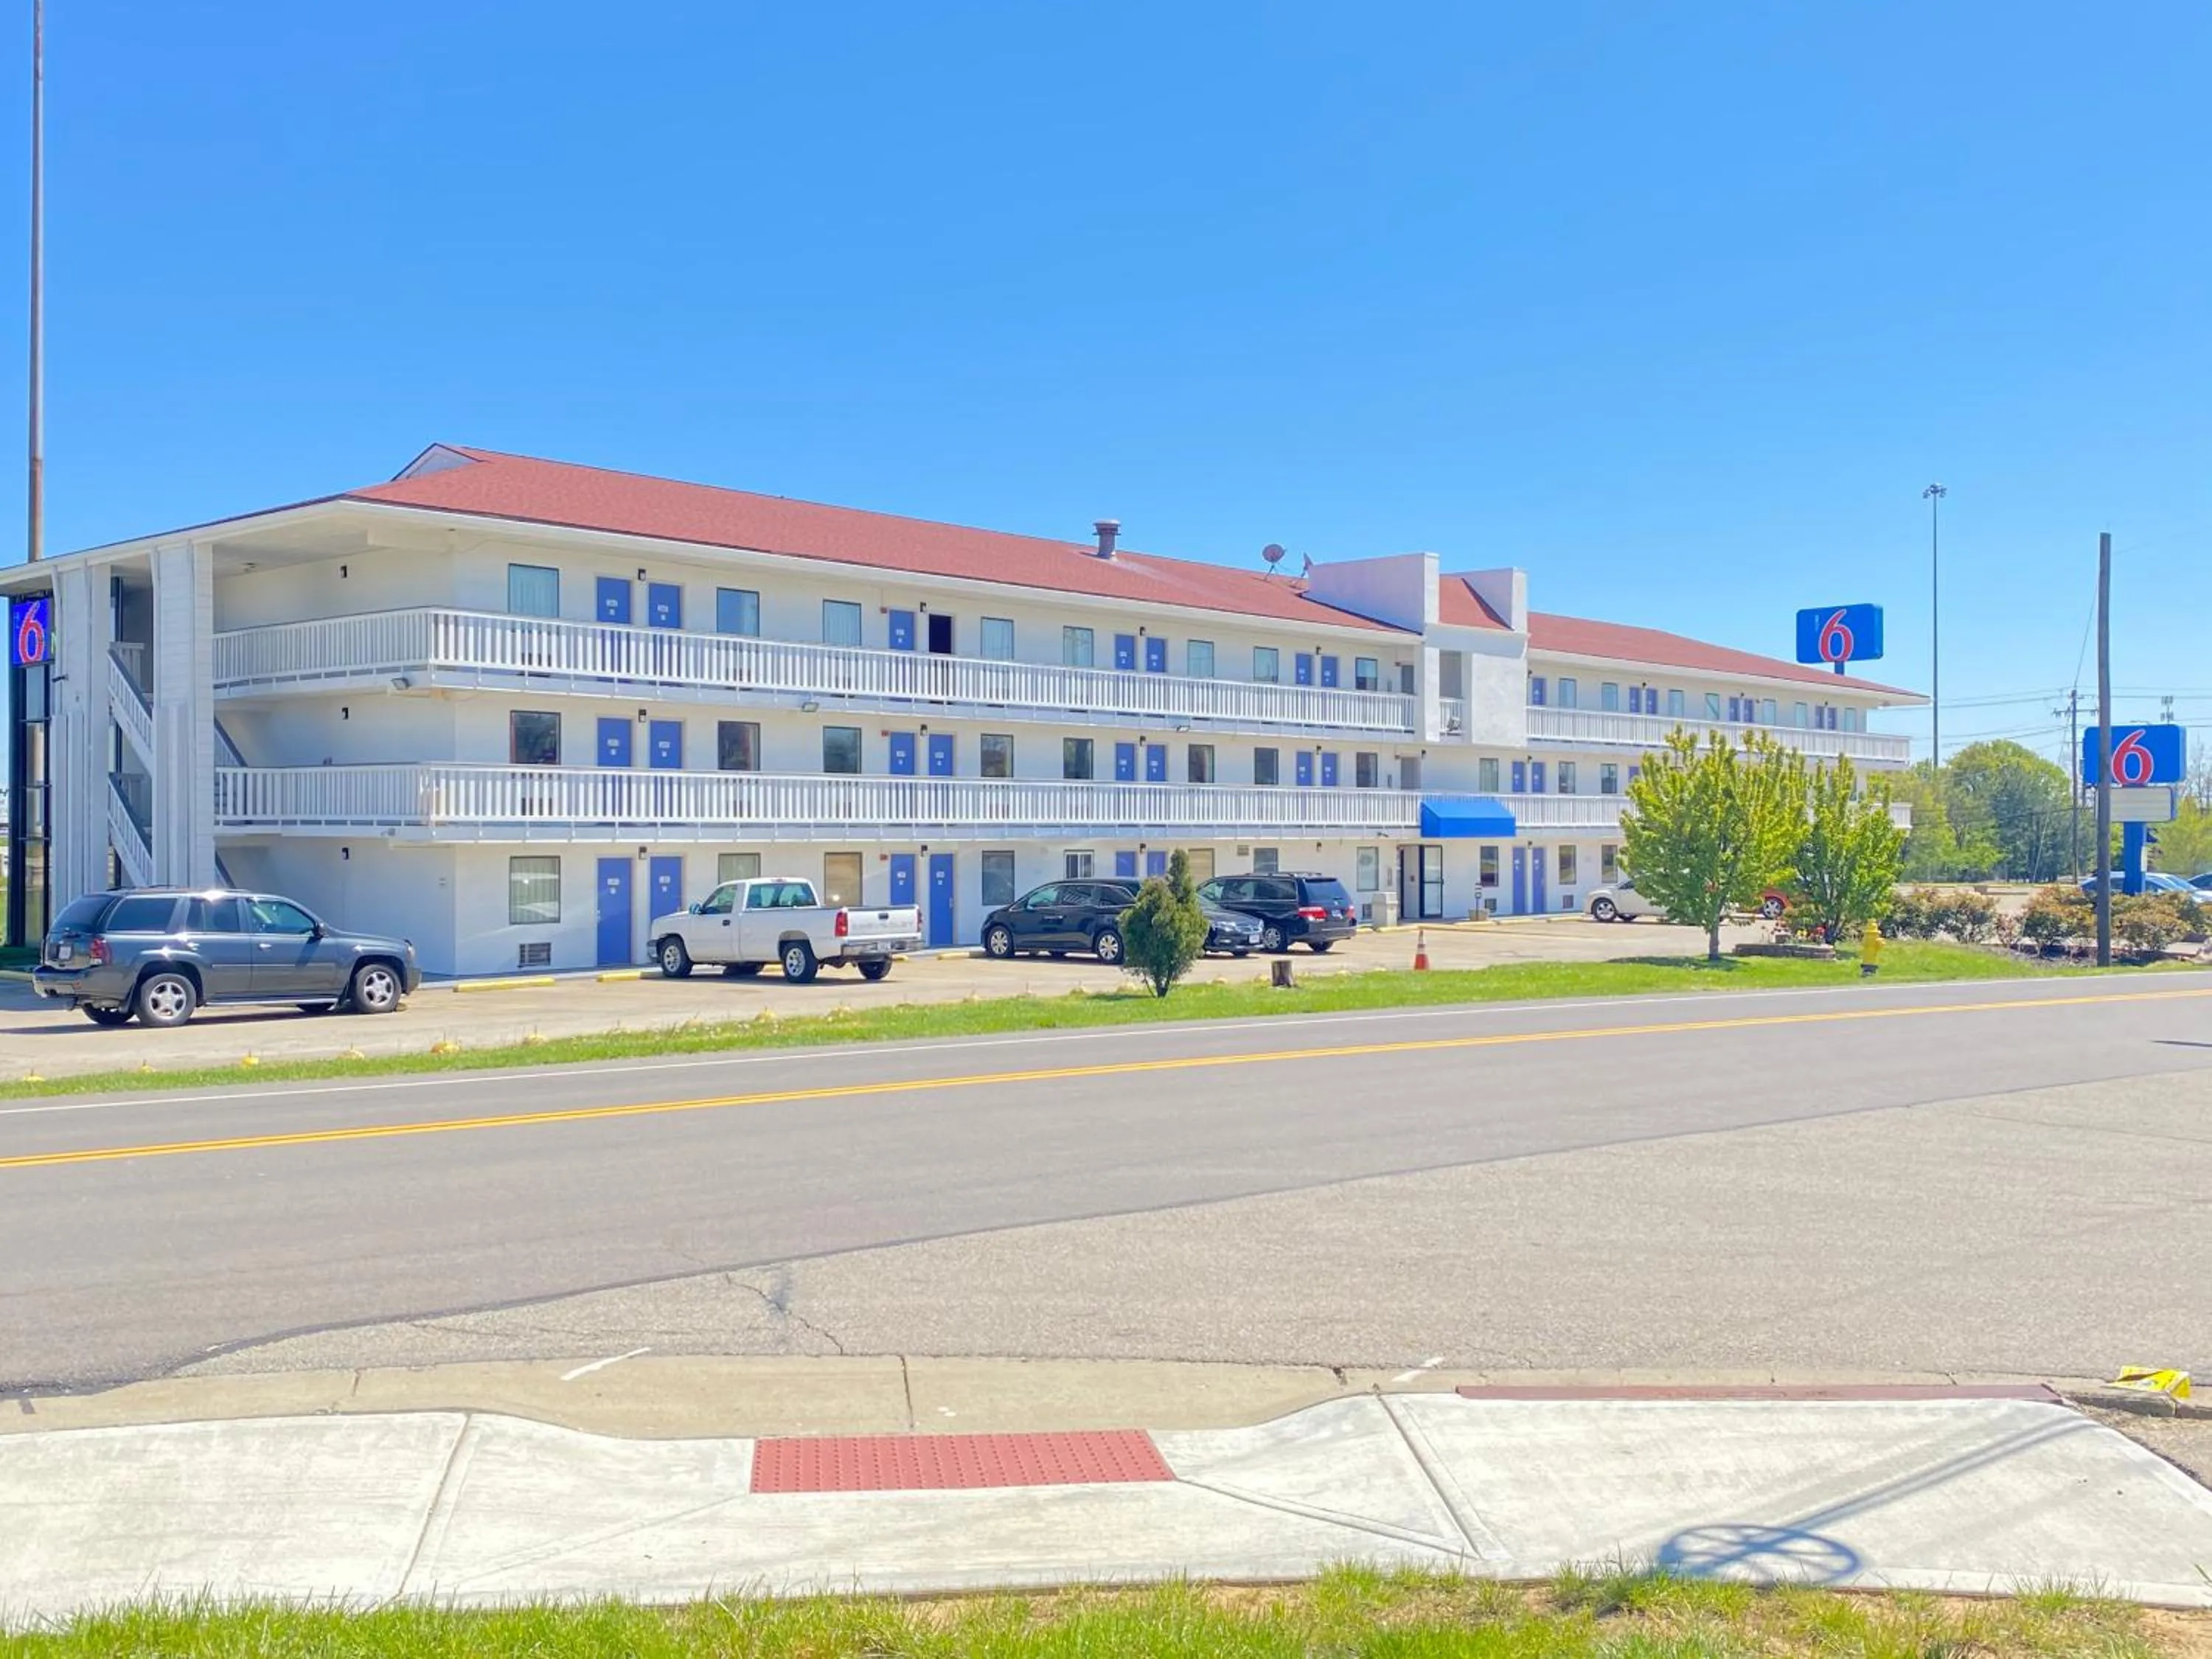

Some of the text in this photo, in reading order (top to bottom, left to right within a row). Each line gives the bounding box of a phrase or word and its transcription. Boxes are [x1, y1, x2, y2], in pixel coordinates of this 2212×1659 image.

[18, 600, 44, 664] 6
[1818, 608, 1854, 661] 6
[2111, 728, 2154, 786] 6
